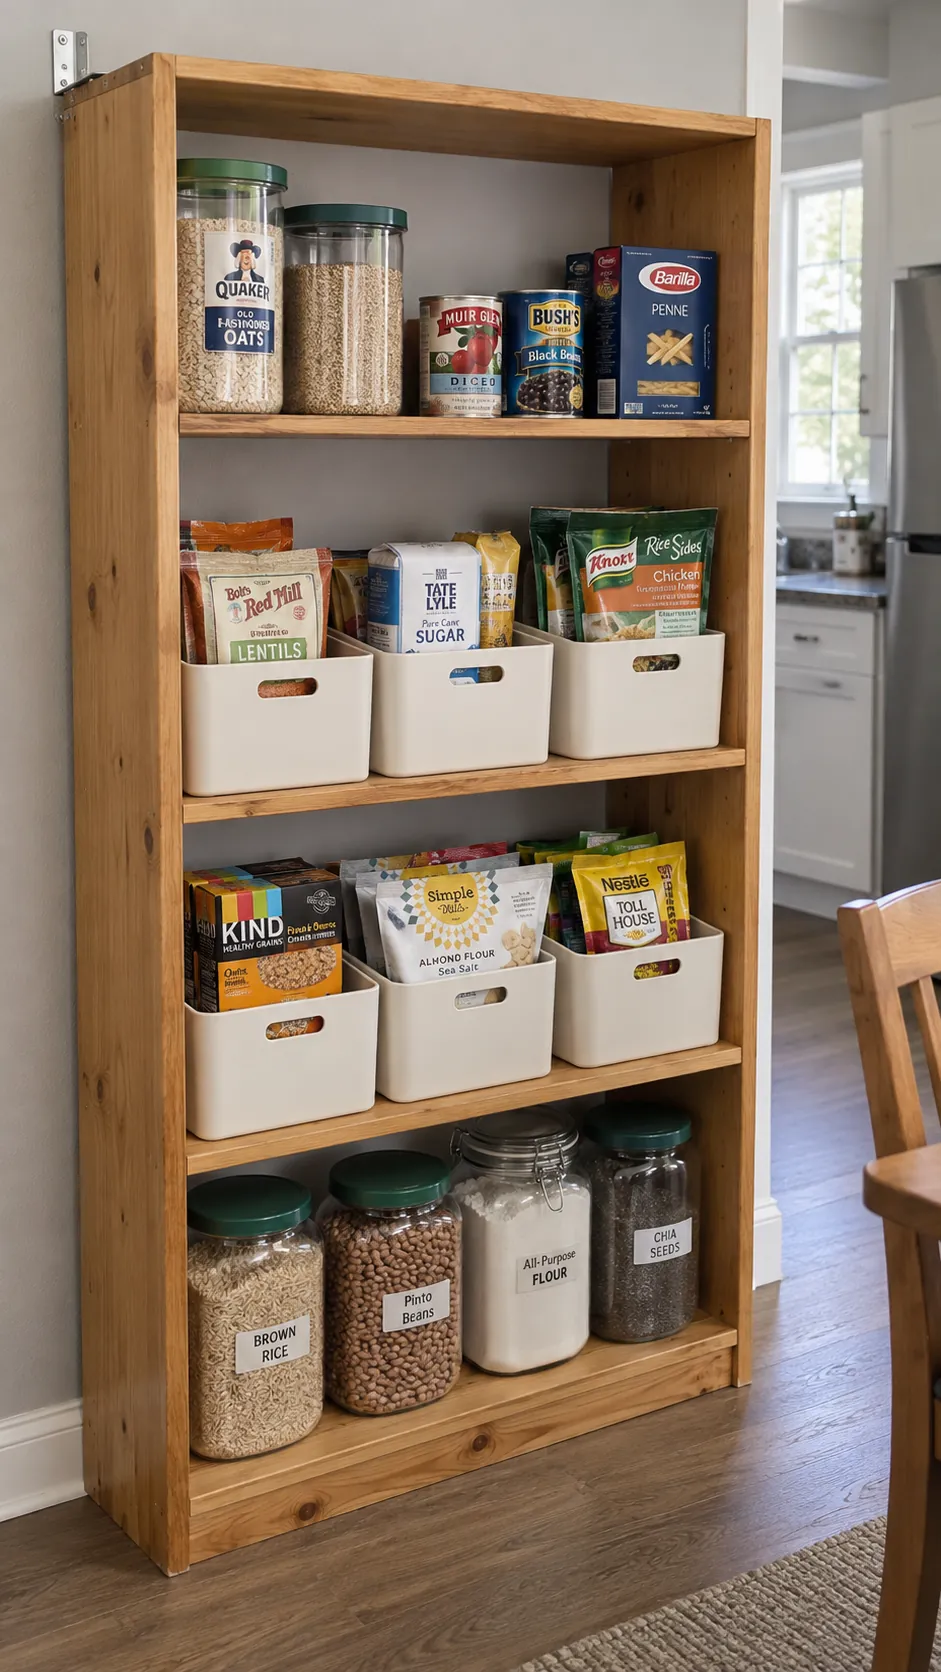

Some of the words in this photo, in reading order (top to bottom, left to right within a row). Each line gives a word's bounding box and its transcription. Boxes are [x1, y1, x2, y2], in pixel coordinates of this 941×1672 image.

[654, 270, 696, 287] Barilla
[216, 281, 270, 301] QUAKER
[445, 310, 476, 326] MUIR
[533, 309, 579, 327] BUSH'S
[652, 303, 689, 317] PENNE
[224, 330, 264, 346] OATS
[528, 349, 558, 362] Black
[644, 536, 671, 556] Rice
[670, 533, 702, 560] Sides
[653, 568, 700, 583] Chicken
[425, 583, 457, 597] TATE
[243, 591, 274, 622] Red
[272, 581, 303, 612] Mill
[426, 597, 457, 610] LYLE
[416, 628, 465, 643] SUGAR
[238, 642, 302, 662] LENTILS
[427, 886, 475, 903] Simple
[616, 899, 647, 914] TOLL
[613, 911, 657, 930] HOUSE
[222, 916, 284, 944] KIND
[464, 949, 495, 960] FLOUR
[438, 967, 456, 976] Sea
[458, 964, 479, 973] Salt
[654, 1228, 677, 1243] CHIA
[650, 1242, 680, 1259] SEEDS
[523, 1250, 576, 1270] All-Purpose
[532, 1266, 568, 1286] FLOUR
[404, 1292, 432, 1307] Pinto
[402, 1307, 434, 1325] Beans
[254, 1325, 296, 1347] BROWN
[262, 1345, 289, 1363] RICE
